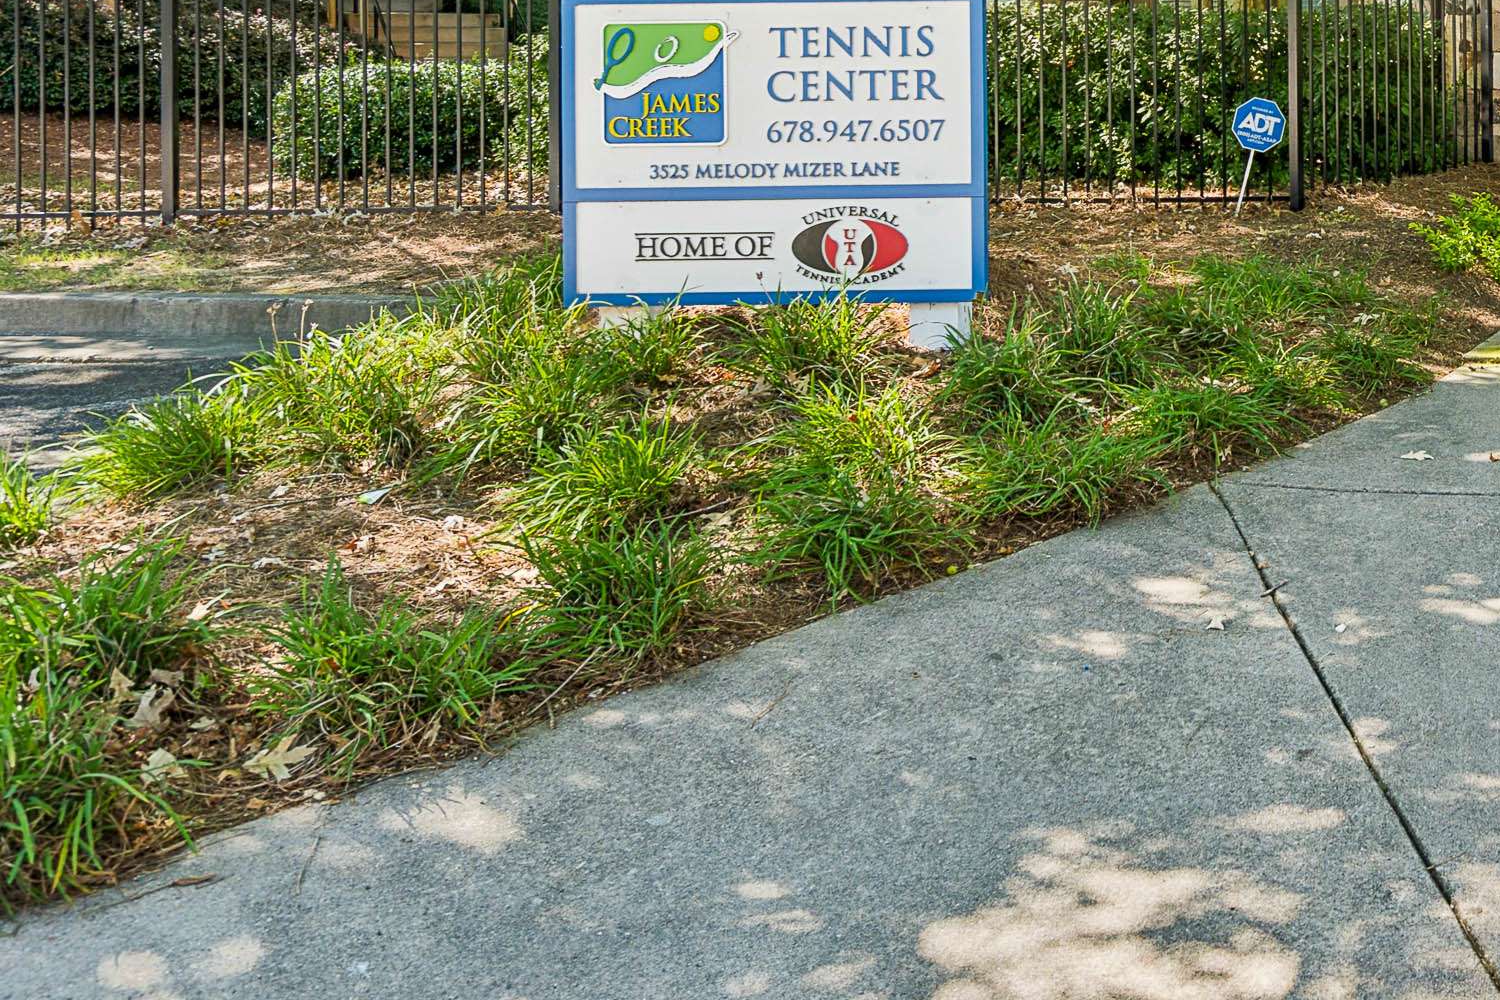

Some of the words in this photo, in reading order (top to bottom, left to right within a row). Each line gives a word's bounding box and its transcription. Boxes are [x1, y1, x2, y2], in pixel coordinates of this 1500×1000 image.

[769, 25, 935, 58] TENNIS
[766, 69, 945, 103] CENTER
[641, 92, 721, 119] JAMES
[607, 115, 692, 139] CREEK
[766, 119, 946, 144] 678.947.6507
[1238, 112, 1281, 135] ADT
[649, 164, 690, 180] 3525
[695, 163, 780, 179] MELODY
[783, 162, 847, 178] MIZER
[850, 161, 901, 177] LANE
[802, 206, 899, 227] UNIVERSAL
[637, 236, 729, 260] HOME
[734, 236, 774, 260] OF
[795, 263, 841, 285] TENNIS
[845, 262, 906, 285] ACADEMY
